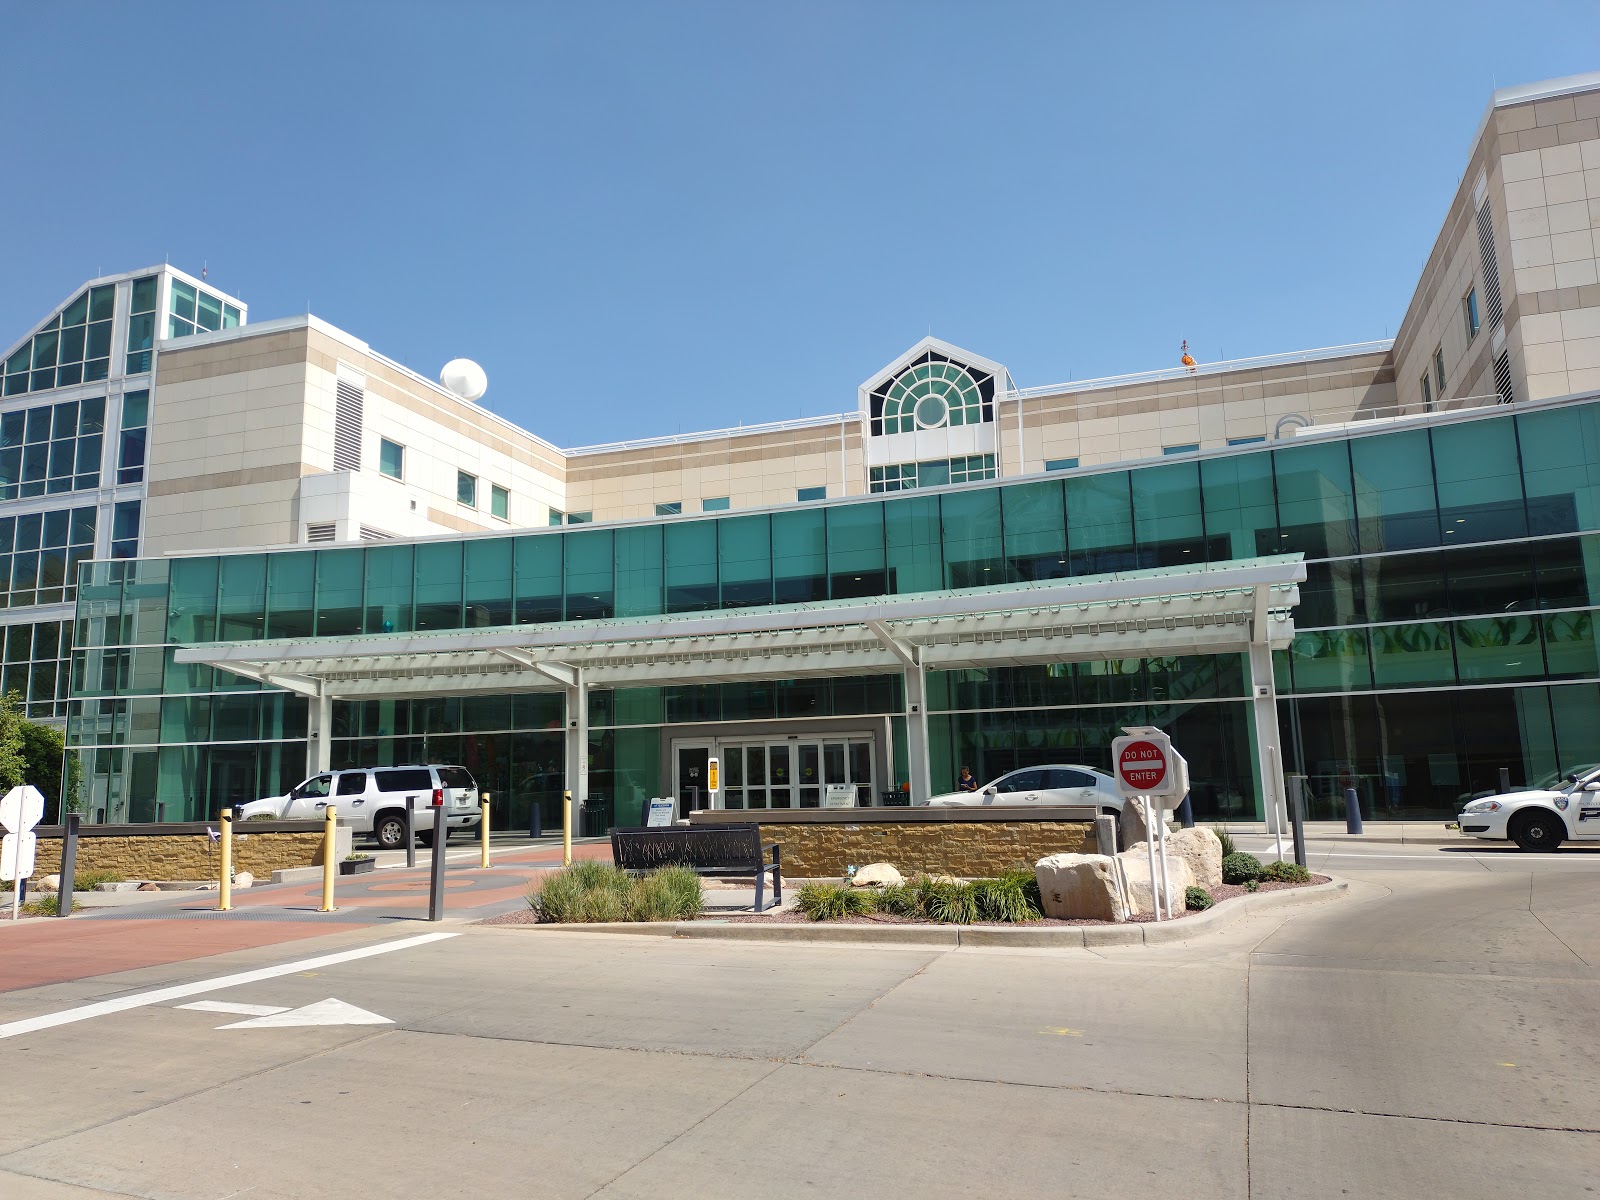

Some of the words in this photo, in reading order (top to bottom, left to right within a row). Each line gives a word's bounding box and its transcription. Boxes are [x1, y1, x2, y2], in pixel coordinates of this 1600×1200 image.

[1125, 751, 1137, 759] DO
[1140, 750, 1158, 758] NOT
[1130, 772, 1157, 780] ENTER
